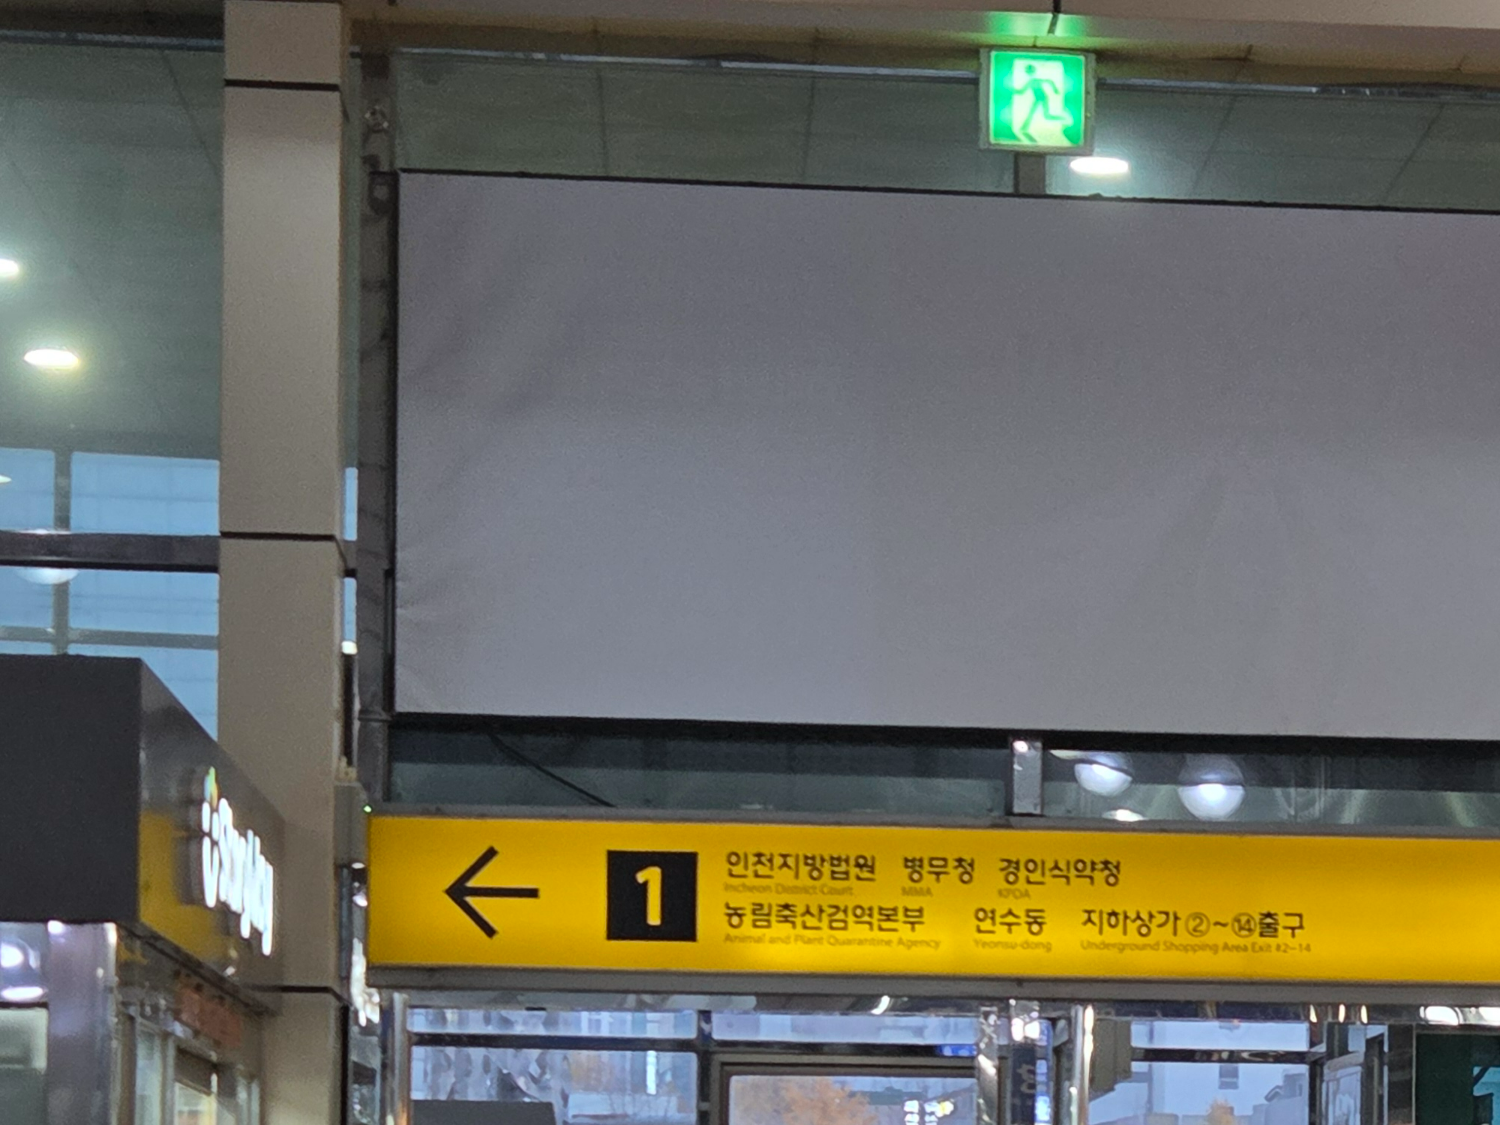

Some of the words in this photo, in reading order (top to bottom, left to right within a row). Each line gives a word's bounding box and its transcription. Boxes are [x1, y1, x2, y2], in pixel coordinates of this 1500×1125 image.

[726, 851, 876, 881] 인천지방법원
[903, 856, 975, 885] 병무청
[999, 858, 1121, 887] 경인식약청
[635, 866, 662, 927] 1
[725, 902, 925, 933] 농림축산검역본부
[975, 907, 1047, 936] 연수동
[1080, 940, 1160, 954] Underground
[1162, 941, 1219, 955] Shopping
